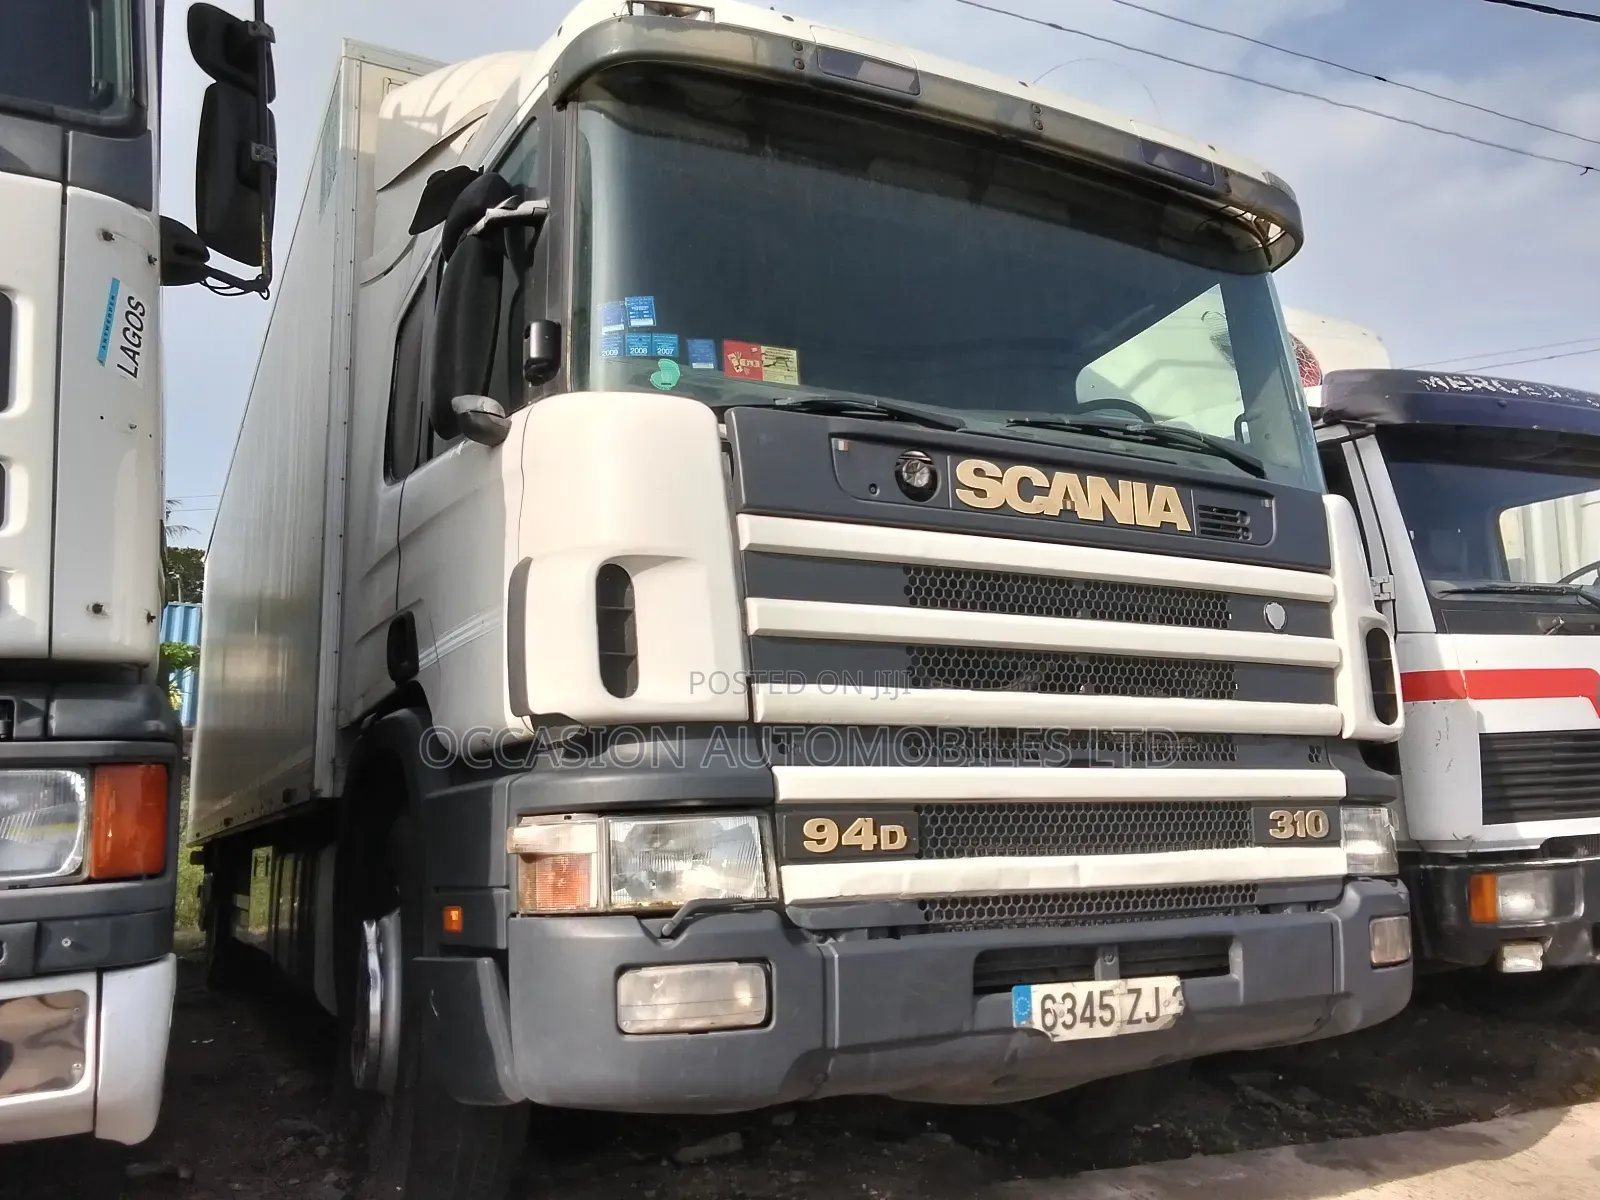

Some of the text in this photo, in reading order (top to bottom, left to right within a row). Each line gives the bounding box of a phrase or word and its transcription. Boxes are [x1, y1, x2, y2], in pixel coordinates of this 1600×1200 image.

[116, 295, 146, 379] LAGOS
[629, 347, 648, 355] 2008
[656, 347, 674, 355] 2007
[955, 458, 1192, 532] SCANIA
[1269, 809, 1330, 839] 310
[1040, 990, 1116, 1032] 6345
